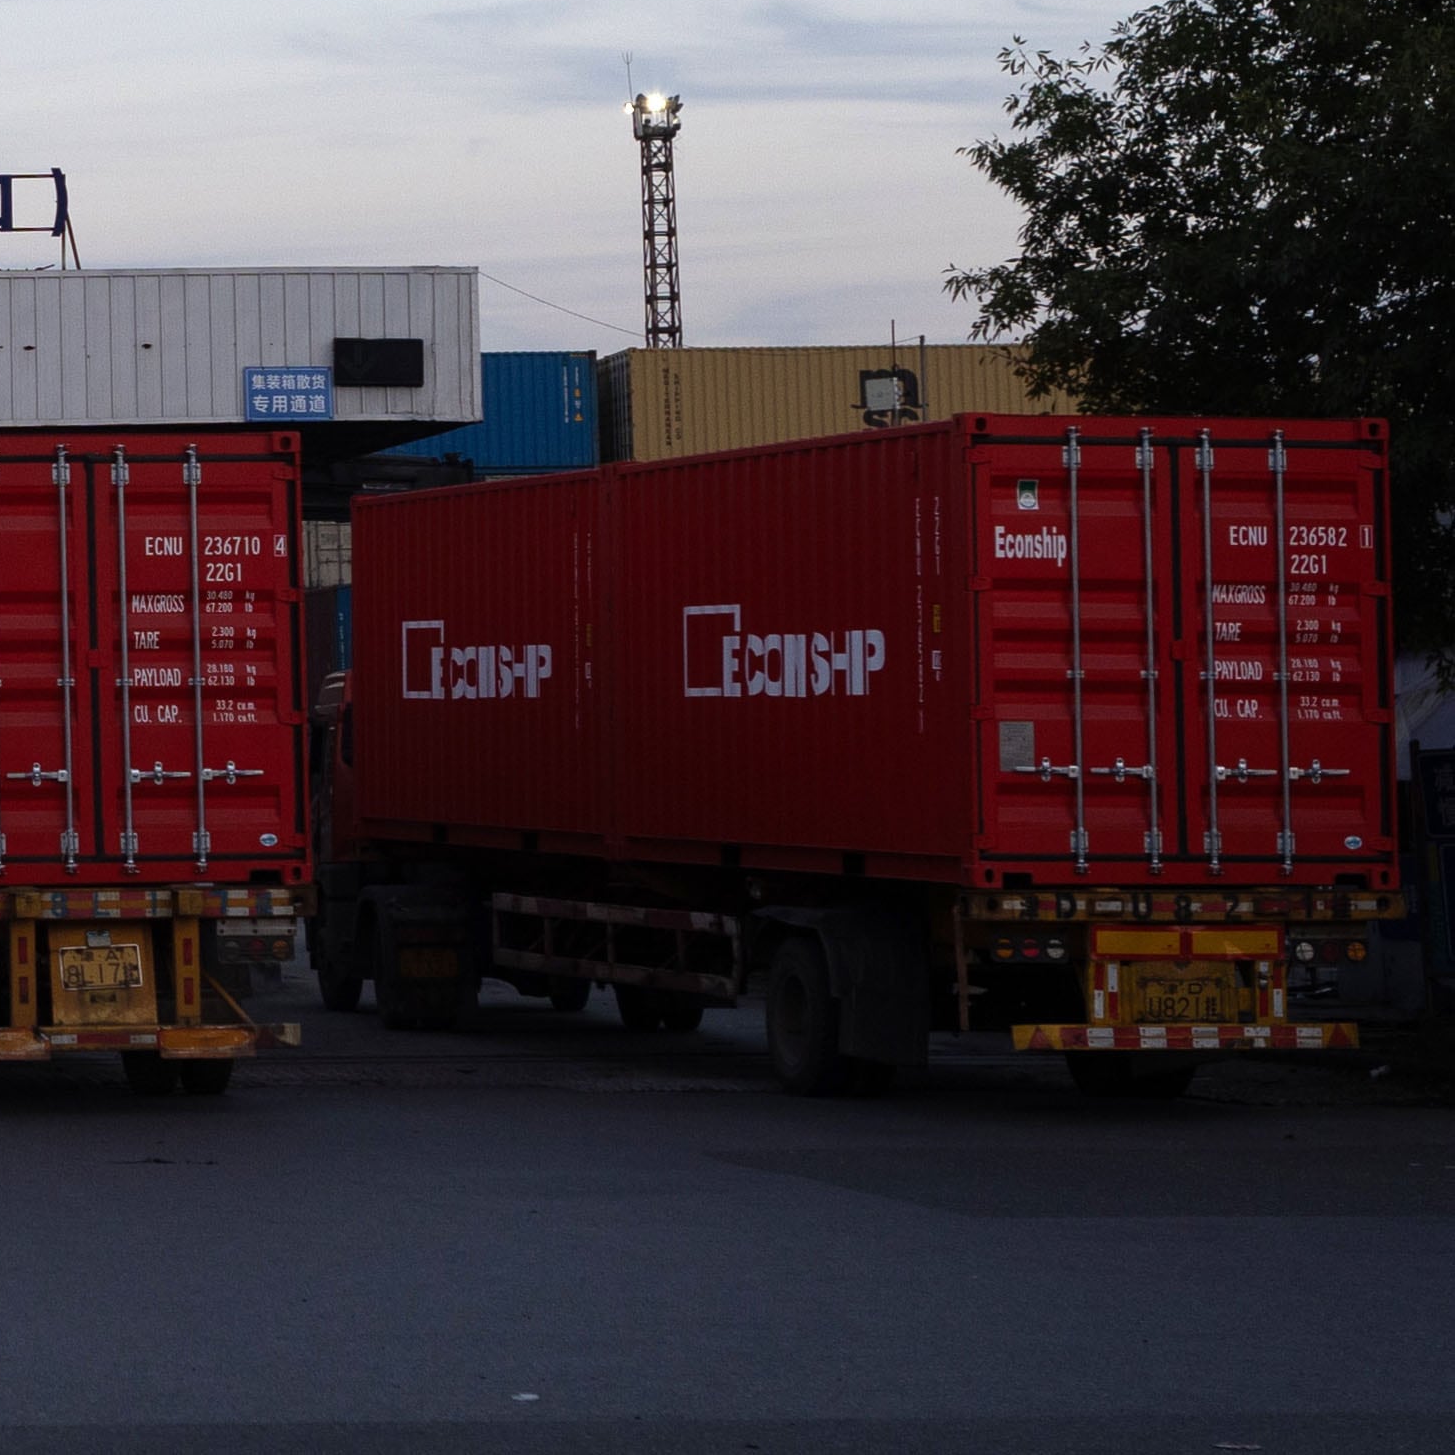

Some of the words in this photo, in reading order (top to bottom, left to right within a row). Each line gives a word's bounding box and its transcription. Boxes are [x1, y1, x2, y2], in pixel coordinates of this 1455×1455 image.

[251, 372, 327, 392] 集装箱散货
[251, 394, 327, 415] 专用通道
[144, 536, 184, 556] ECNU
[203, 535, 262, 557] 236710
[993, 525, 1068, 567] Econship
[1228, 525, 1268, 547] ECNU
[1288, 525, 1349, 548] 236582
[205, 562, 243, 583] 22G1
[1290, 553, 1328, 575] 22G1
[131, 595, 186, 614] MAXGROSS
[1212, 584, 1266, 605] MAXGROSS
[205, 602, 233, 613] 67.200
[133, 631, 161, 650] TARE
[211, 626, 235, 638] 2.300
[246, 627, 257, 640] kg
[1214, 621, 1242, 642] TARE
[723, 628, 887, 699] ECONSHIP
[1214, 660, 1263, 681] PAYLOAD
[133, 667, 182, 687] PAYLOAD
[207, 675, 235, 687] 62.130
[1292, 671, 1321, 682] 62.130
[133, 704, 153, 724] CU.
[157, 704, 183, 724] CAP.
[216, 700, 234, 711] 33.2
[1213, 698, 1233, 718] CU.
[1236, 698, 1264, 719] CAP.
